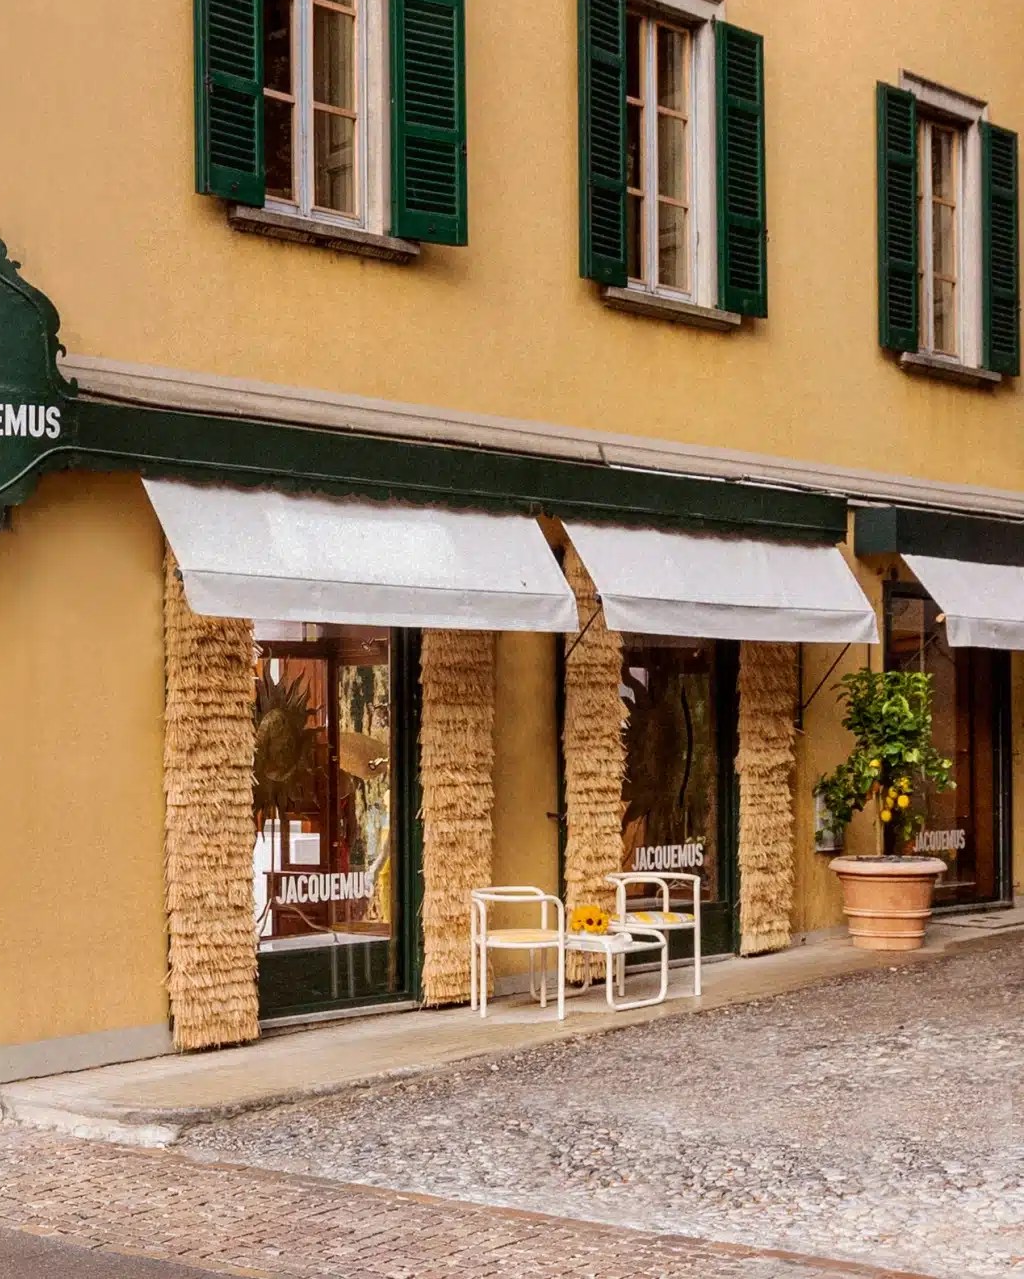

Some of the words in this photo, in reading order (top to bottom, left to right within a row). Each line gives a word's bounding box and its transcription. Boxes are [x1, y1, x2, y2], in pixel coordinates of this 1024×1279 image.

[912, 828, 966, 852] JACQUEMUS
[631, 842, 704, 871] JACQUEMUS
[275, 871, 374, 905] JACQUEMUS
